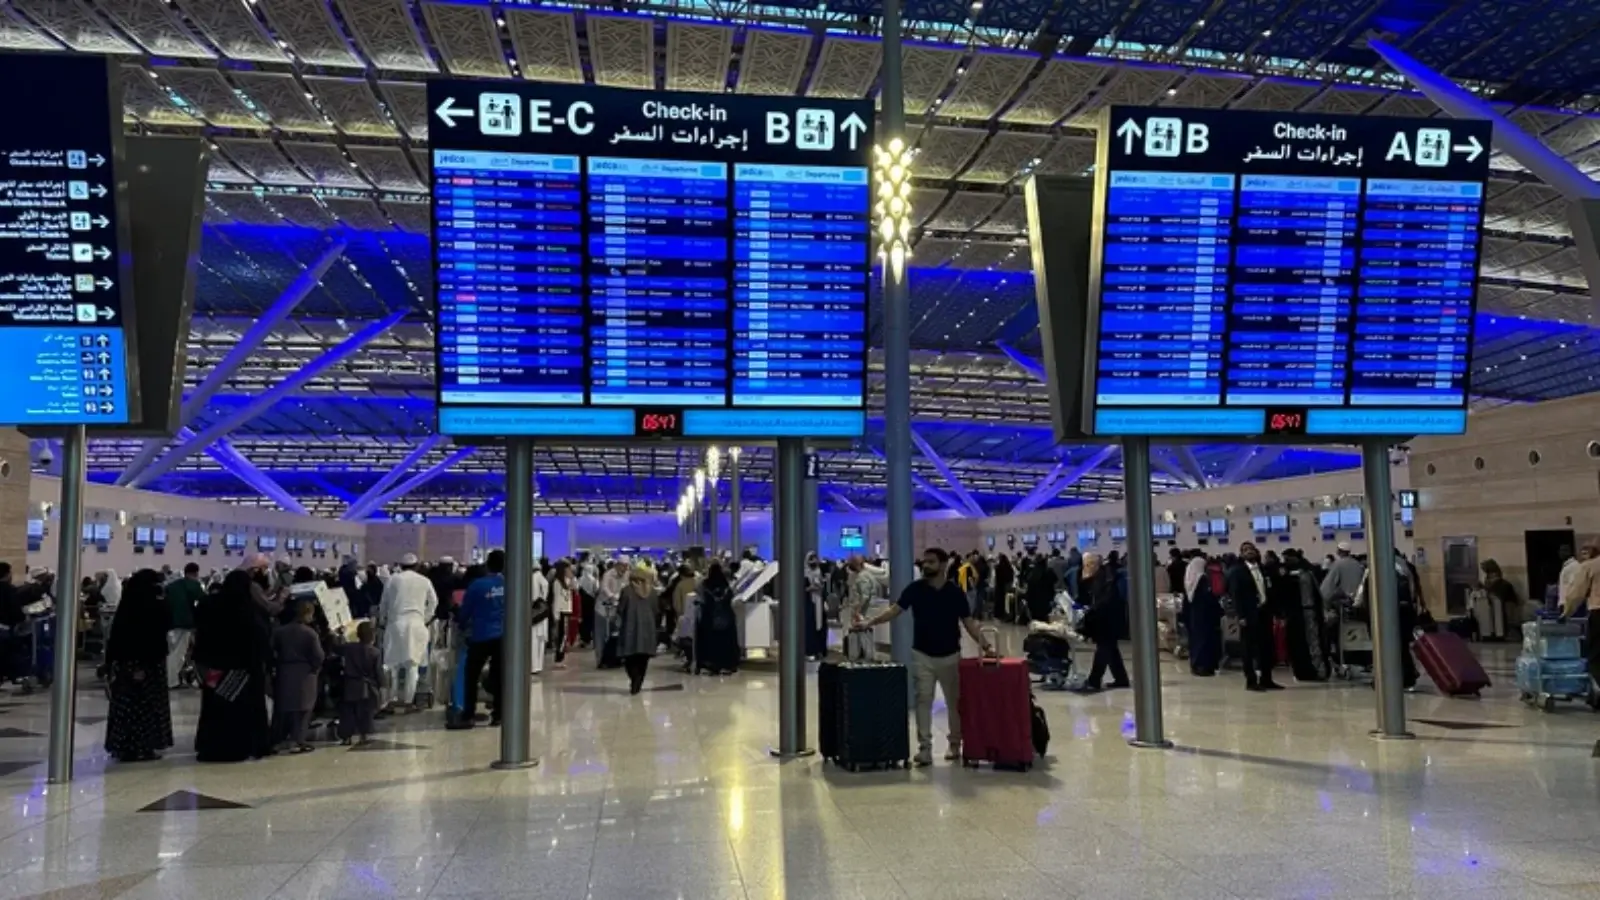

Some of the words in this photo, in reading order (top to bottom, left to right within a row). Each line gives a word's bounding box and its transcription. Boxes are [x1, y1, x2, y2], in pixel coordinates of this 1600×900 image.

[529, 98, 595, 136] E-C
[642, 100, 727, 122] Check-in
[609, 124, 664, 144] السفر
[671, 126, 749, 151] إجراءات
[765, 111, 791, 144] B
[1187, 123, 1210, 154] B
[1273, 121, 1347, 141] Check-in
[1242, 144, 1291, 163] السفر
[1297, 145, 1364, 168] إجراءات
[1385, 131, 1412, 162] A
